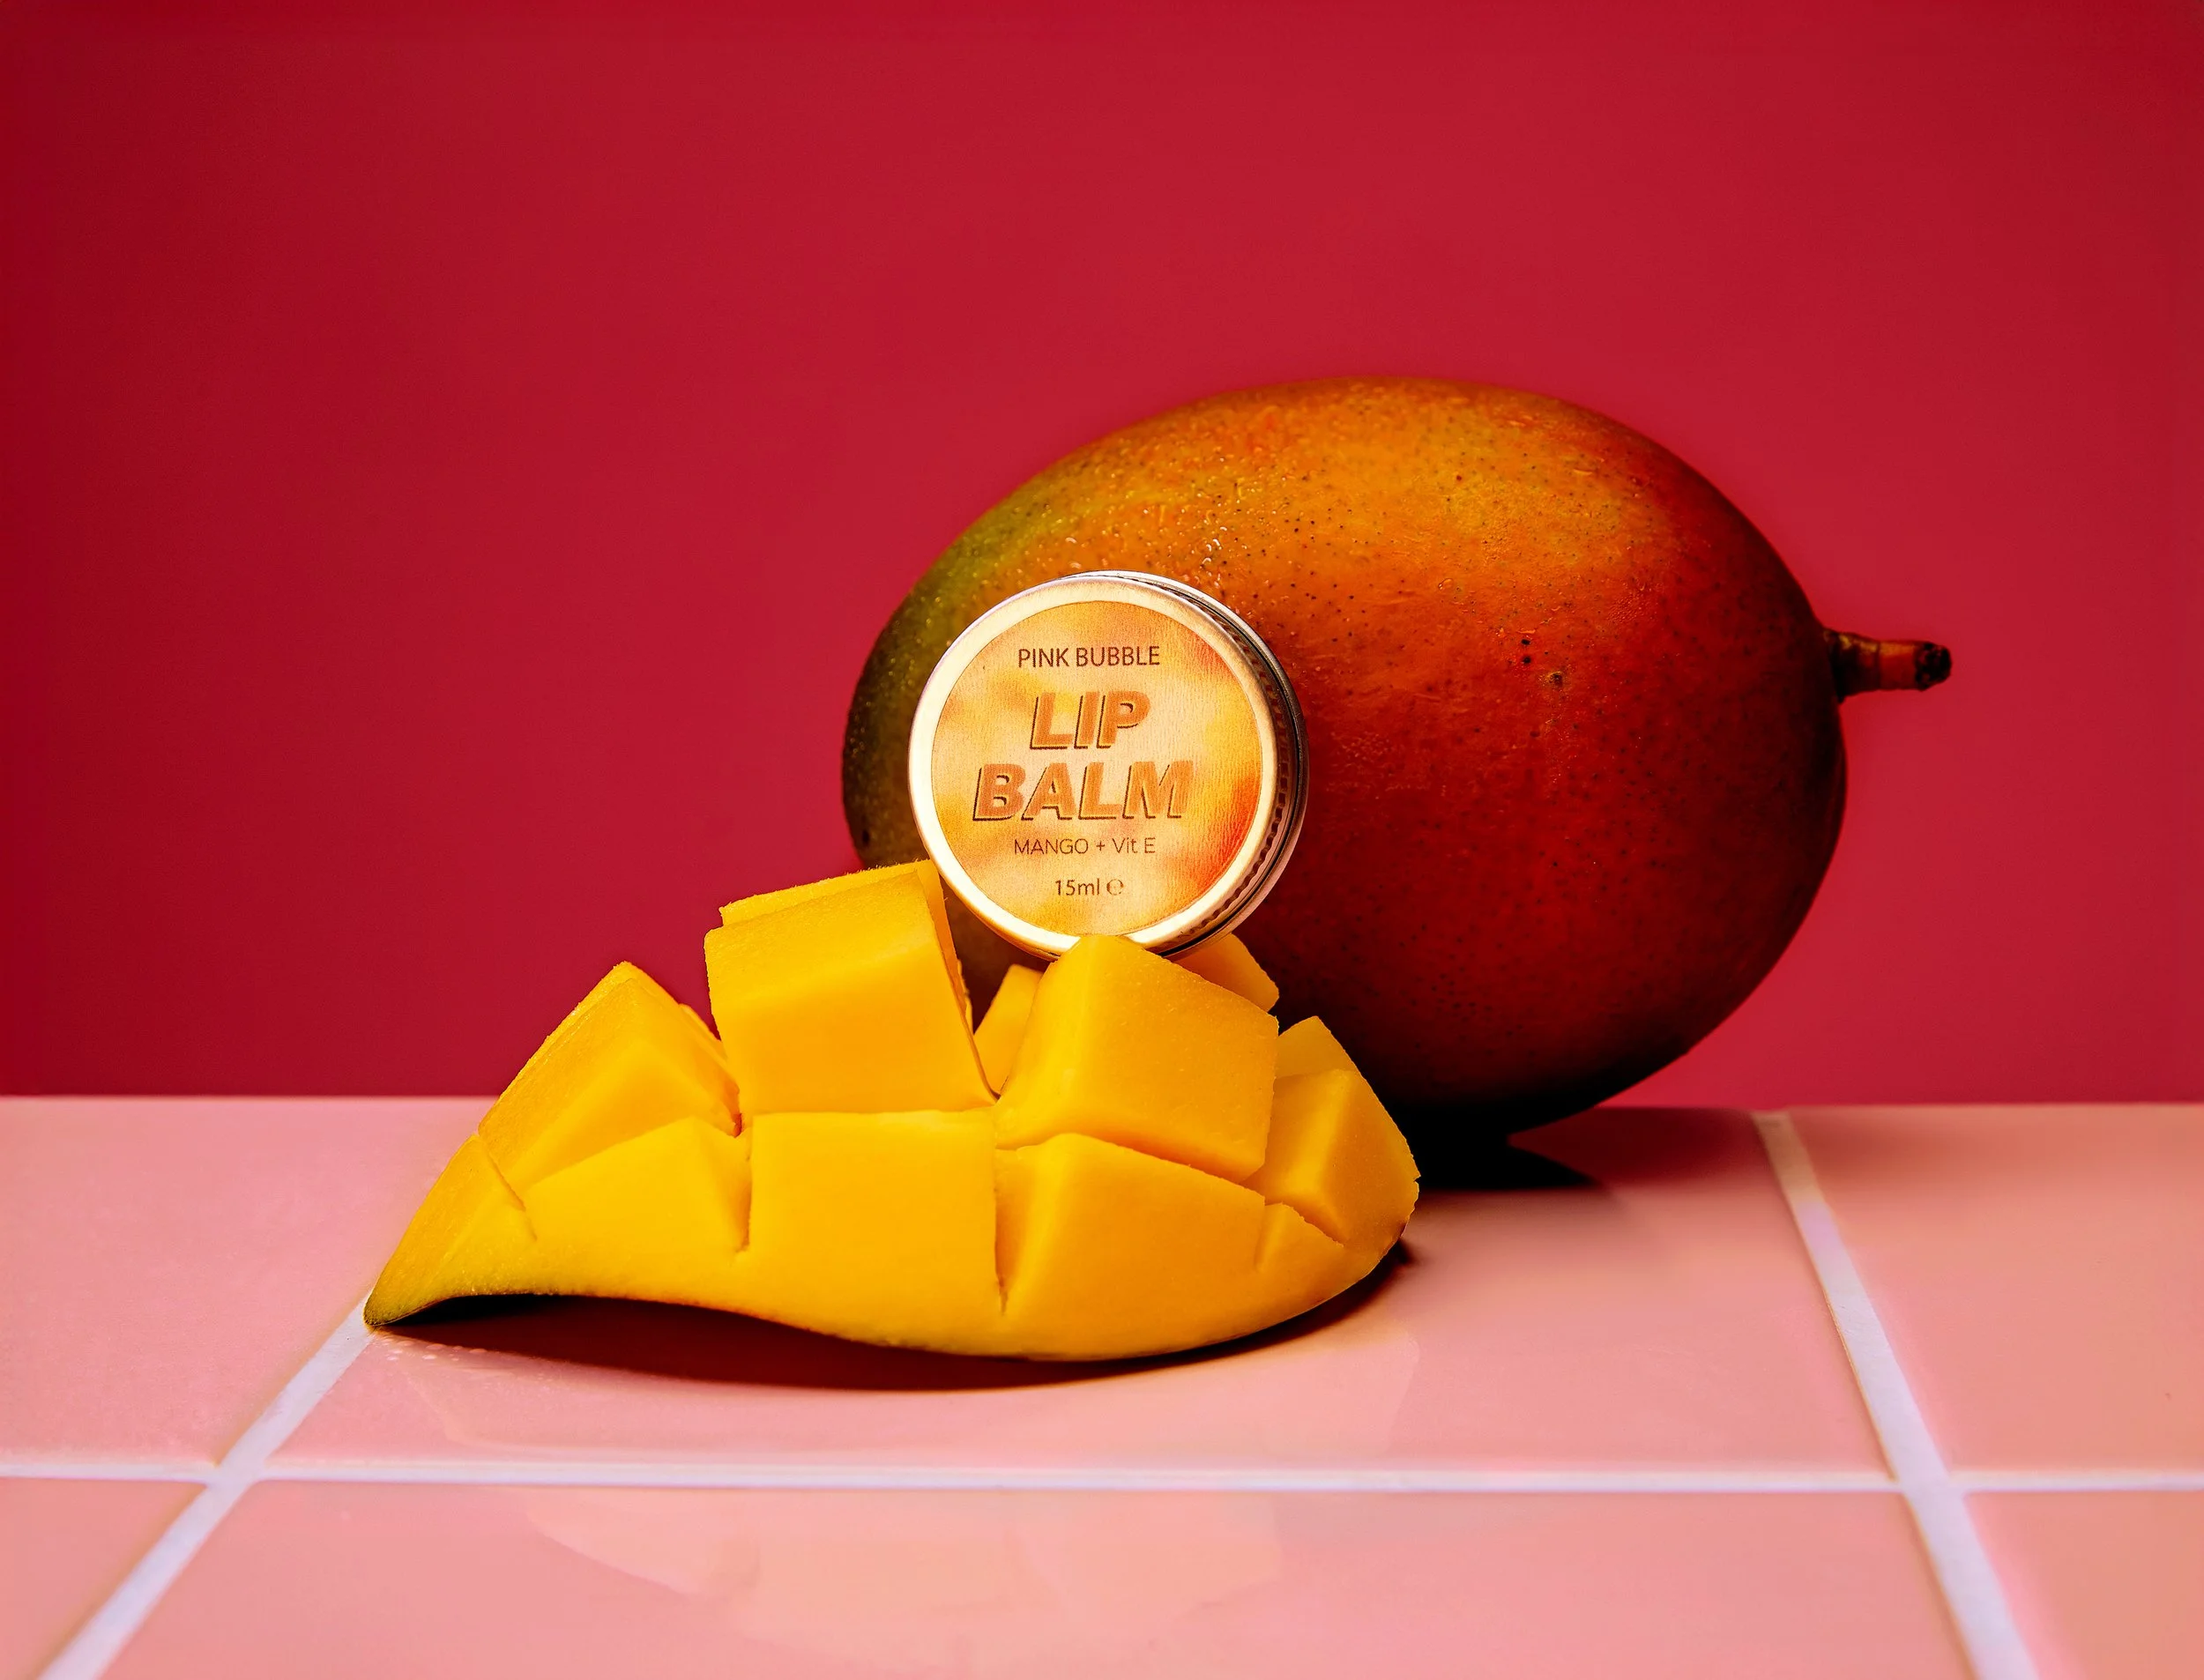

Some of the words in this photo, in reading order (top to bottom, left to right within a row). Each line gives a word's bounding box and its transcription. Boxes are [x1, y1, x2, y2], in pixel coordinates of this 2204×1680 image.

[1017, 646, 1068, 668] PINK
[1076, 645, 1160, 667] BUBBLE
[1029, 690, 1150, 750] LIP
[972, 760, 1194, 821] BALM
[1014, 837, 1089, 856] MANGO
[1112, 836, 1138, 854] Vit
[1143, 837, 1156, 854] E
[1054, 877, 1100, 897] 15ml
